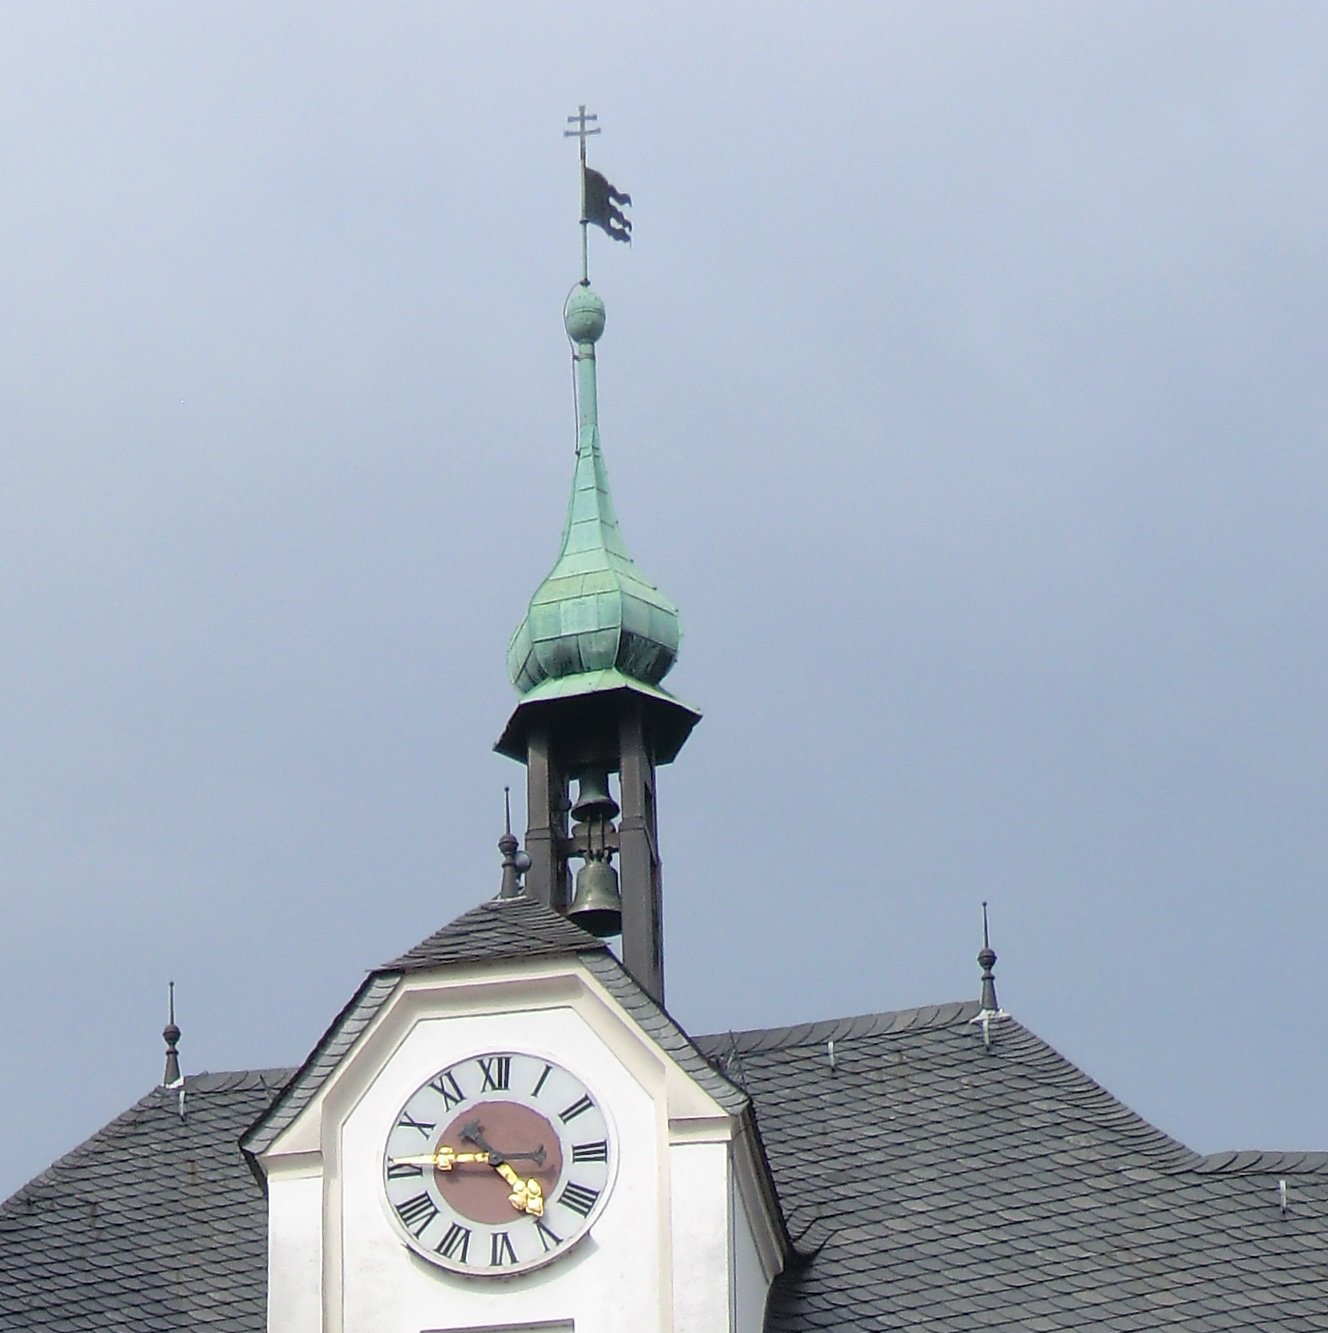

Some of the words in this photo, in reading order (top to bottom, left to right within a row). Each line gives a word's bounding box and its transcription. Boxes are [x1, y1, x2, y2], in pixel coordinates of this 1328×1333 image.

[429, 1070, 467, 1112] XI
[477, 1057, 512, 1092] XII
[532, 1064, 552, 1097] I
[398, 1111, 436, 1140] X
[558, 1094, 595, 1124] II
[572, 1140, 608, 1164] III
[396, 1191, 441, 1240] VIII
[558, 1182, 600, 1218] IIII
[434, 1222, 472, 1264] VII
[489, 1231, 520, 1266] VI
[533, 1219, 564, 1252] V
